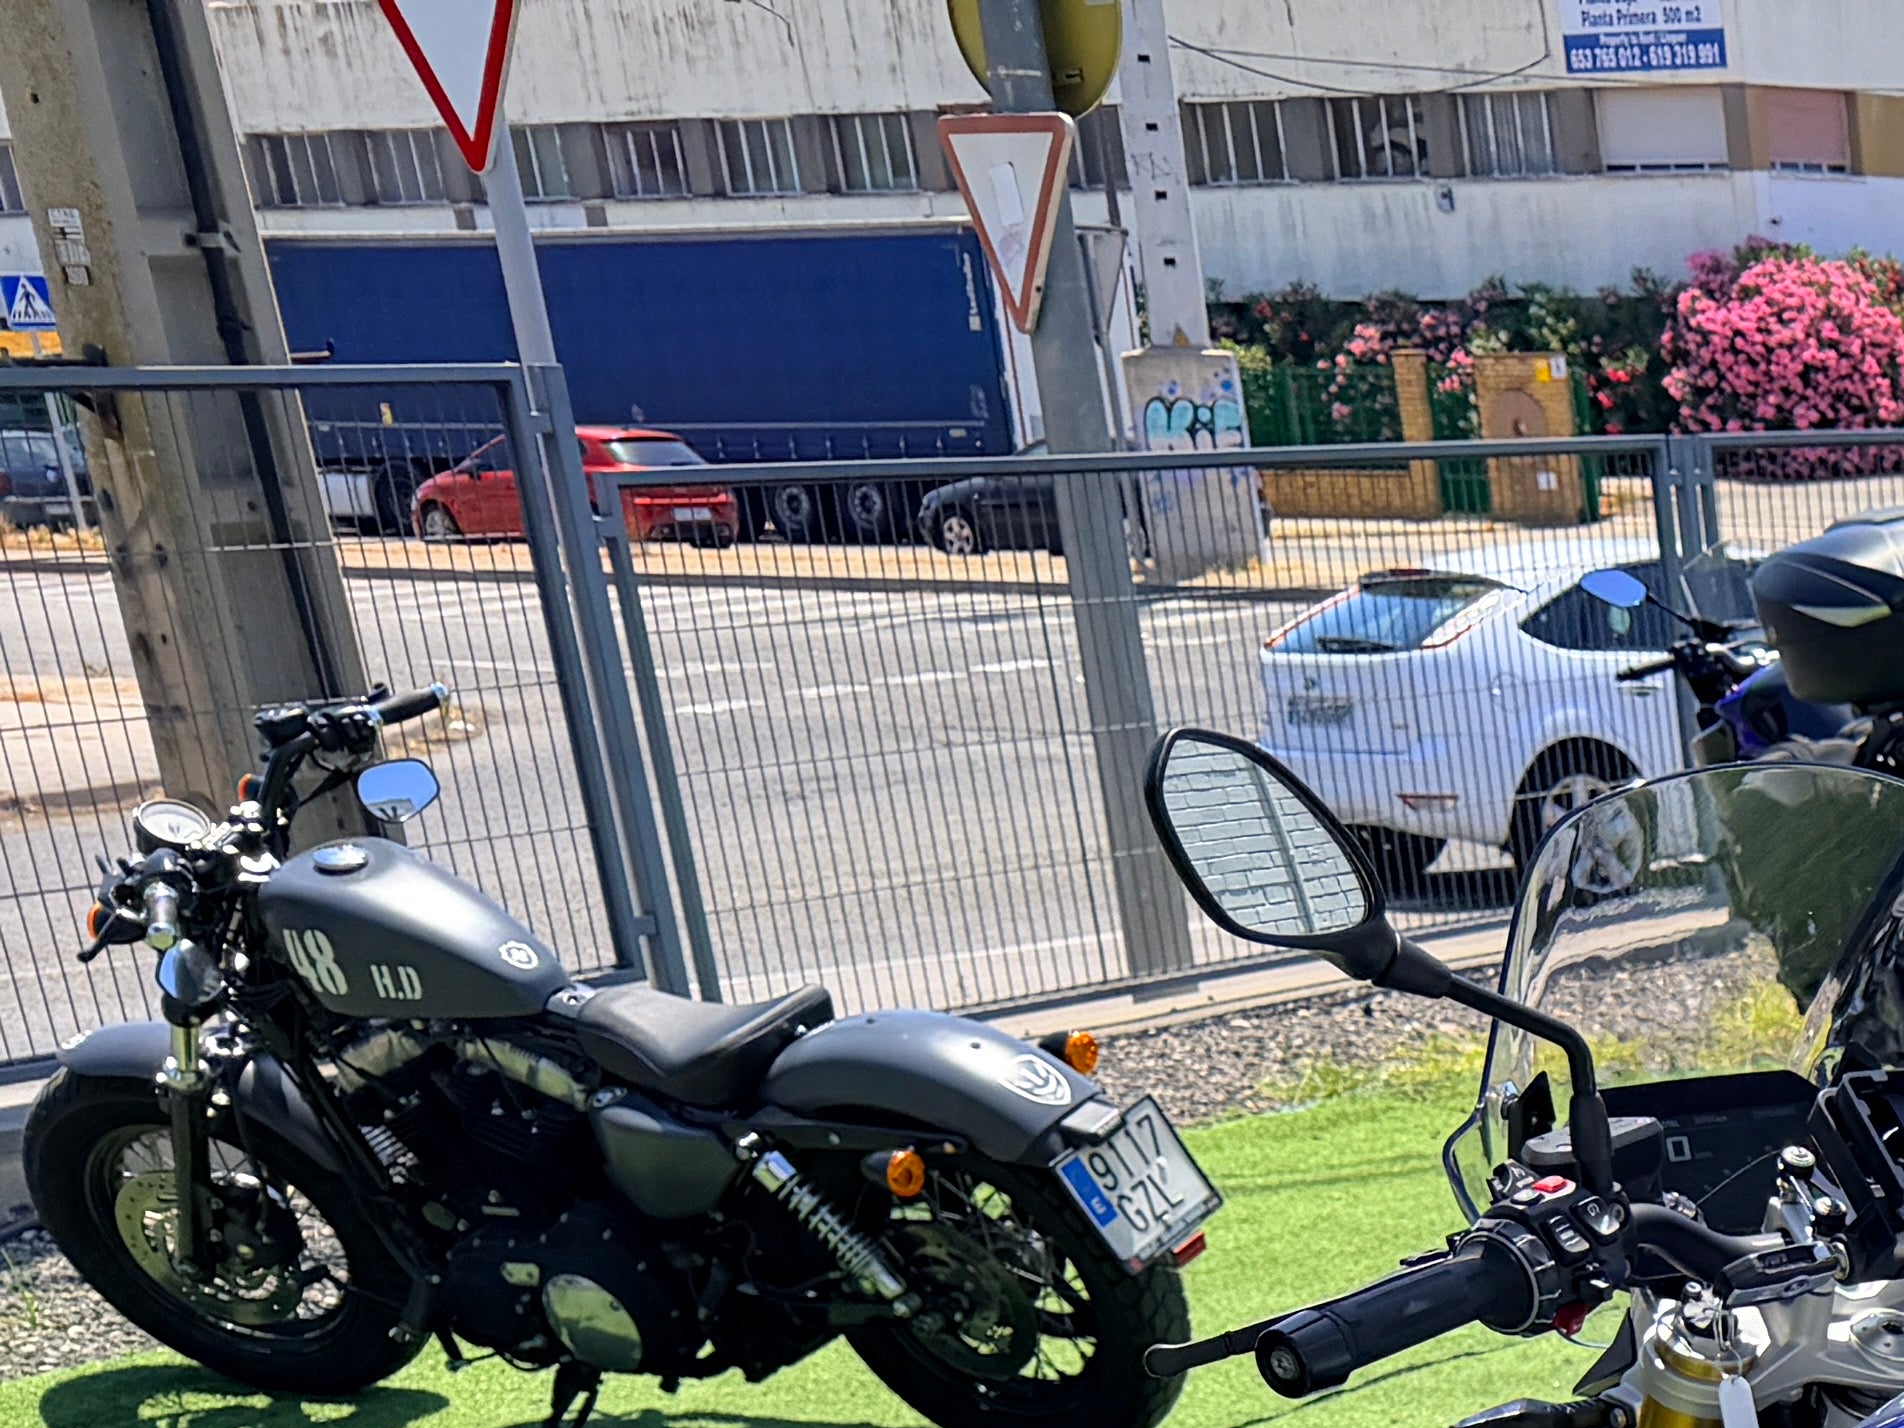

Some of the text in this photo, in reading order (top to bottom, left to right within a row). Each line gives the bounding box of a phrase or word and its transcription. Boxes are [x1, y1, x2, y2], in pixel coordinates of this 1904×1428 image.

[1581, 11, 1613, 27] Planta
[1616, 9, 1656, 25] Primera
[1570, 48, 1593, 69] 653
[1618, 47, 1642, 67] 012
[282, 928, 348, 995] 48
[370, 964, 422, 1000] H.D
[1088, 1114, 1161, 1191] 9117
[1115, 1173, 1185, 1232] GZL
